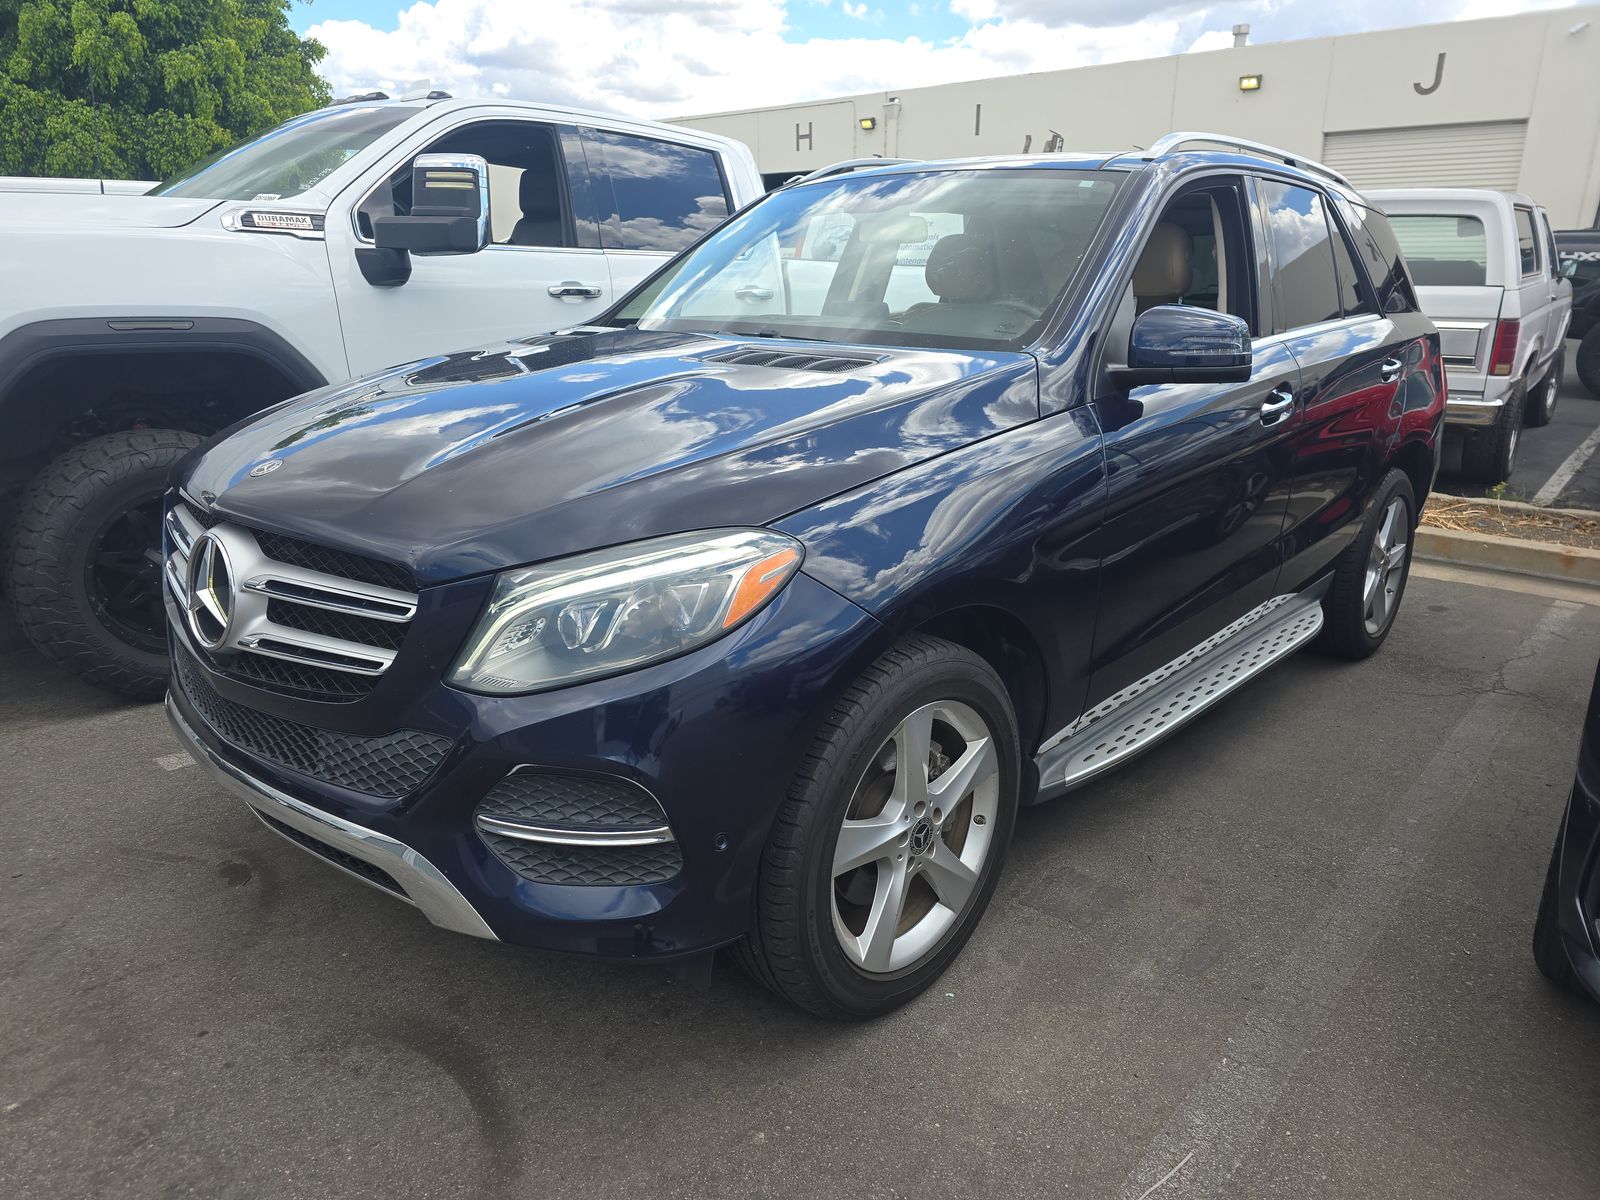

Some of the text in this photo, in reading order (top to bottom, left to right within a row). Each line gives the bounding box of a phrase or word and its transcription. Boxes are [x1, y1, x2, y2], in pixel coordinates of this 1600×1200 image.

[1413, 52, 1447, 96] J
[796, 122, 812, 151] H
[257, 214, 308, 224] DURAMAX
